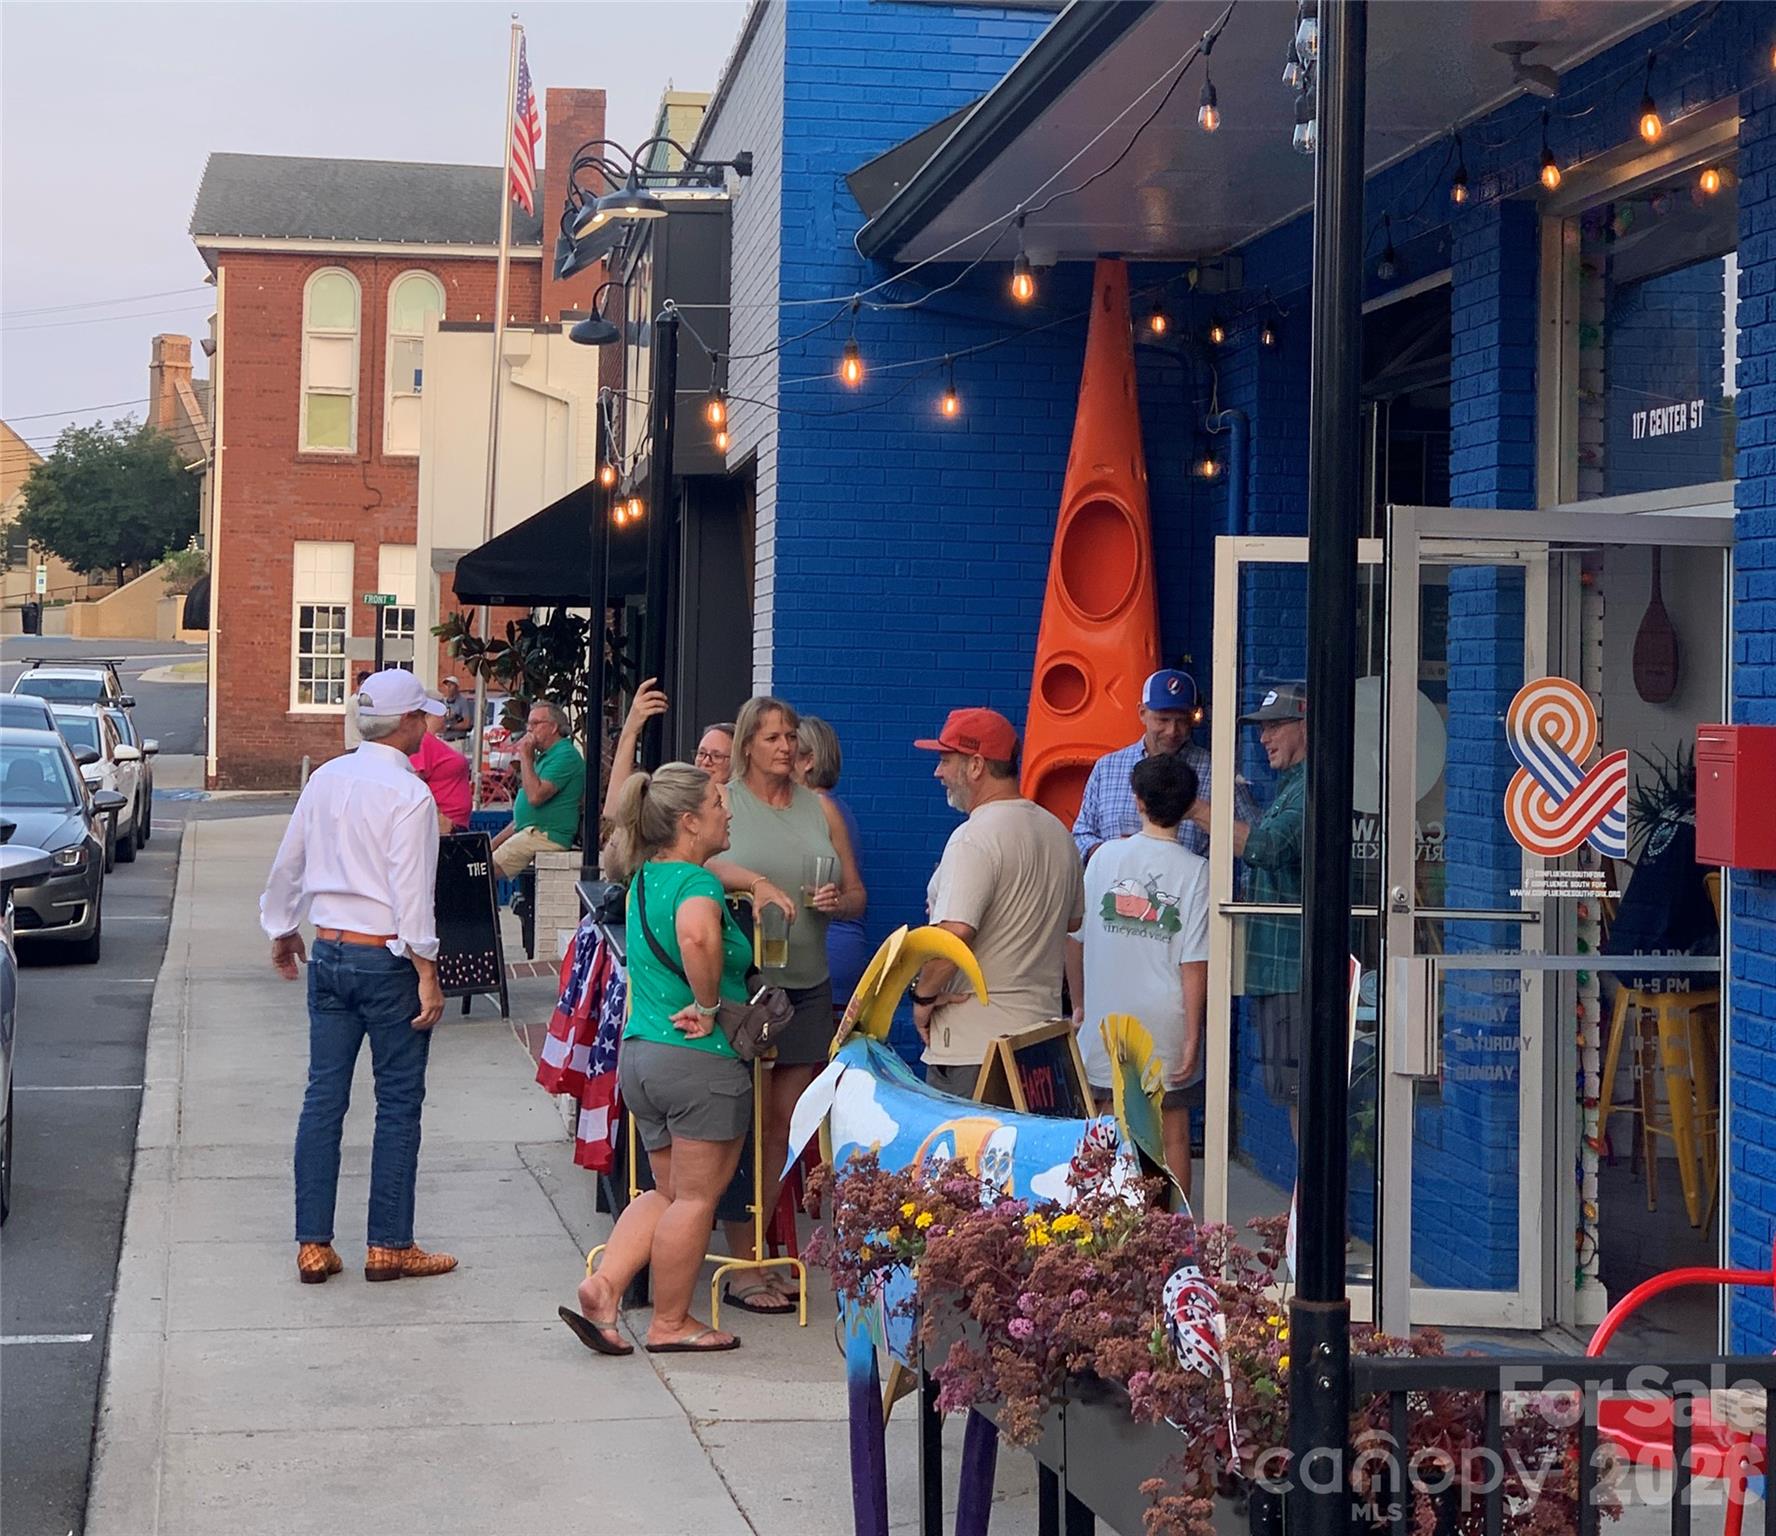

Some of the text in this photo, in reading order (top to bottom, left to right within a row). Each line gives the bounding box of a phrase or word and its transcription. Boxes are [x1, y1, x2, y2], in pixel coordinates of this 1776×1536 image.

[1632, 399, 1704, 439] 117 CENTER ST
[364, 594, 387, 605] FRONT
[466, 862, 487, 877] THE
[1633, 978, 1661, 993] 4-9
[1666, 978, 1690, 993] PM
